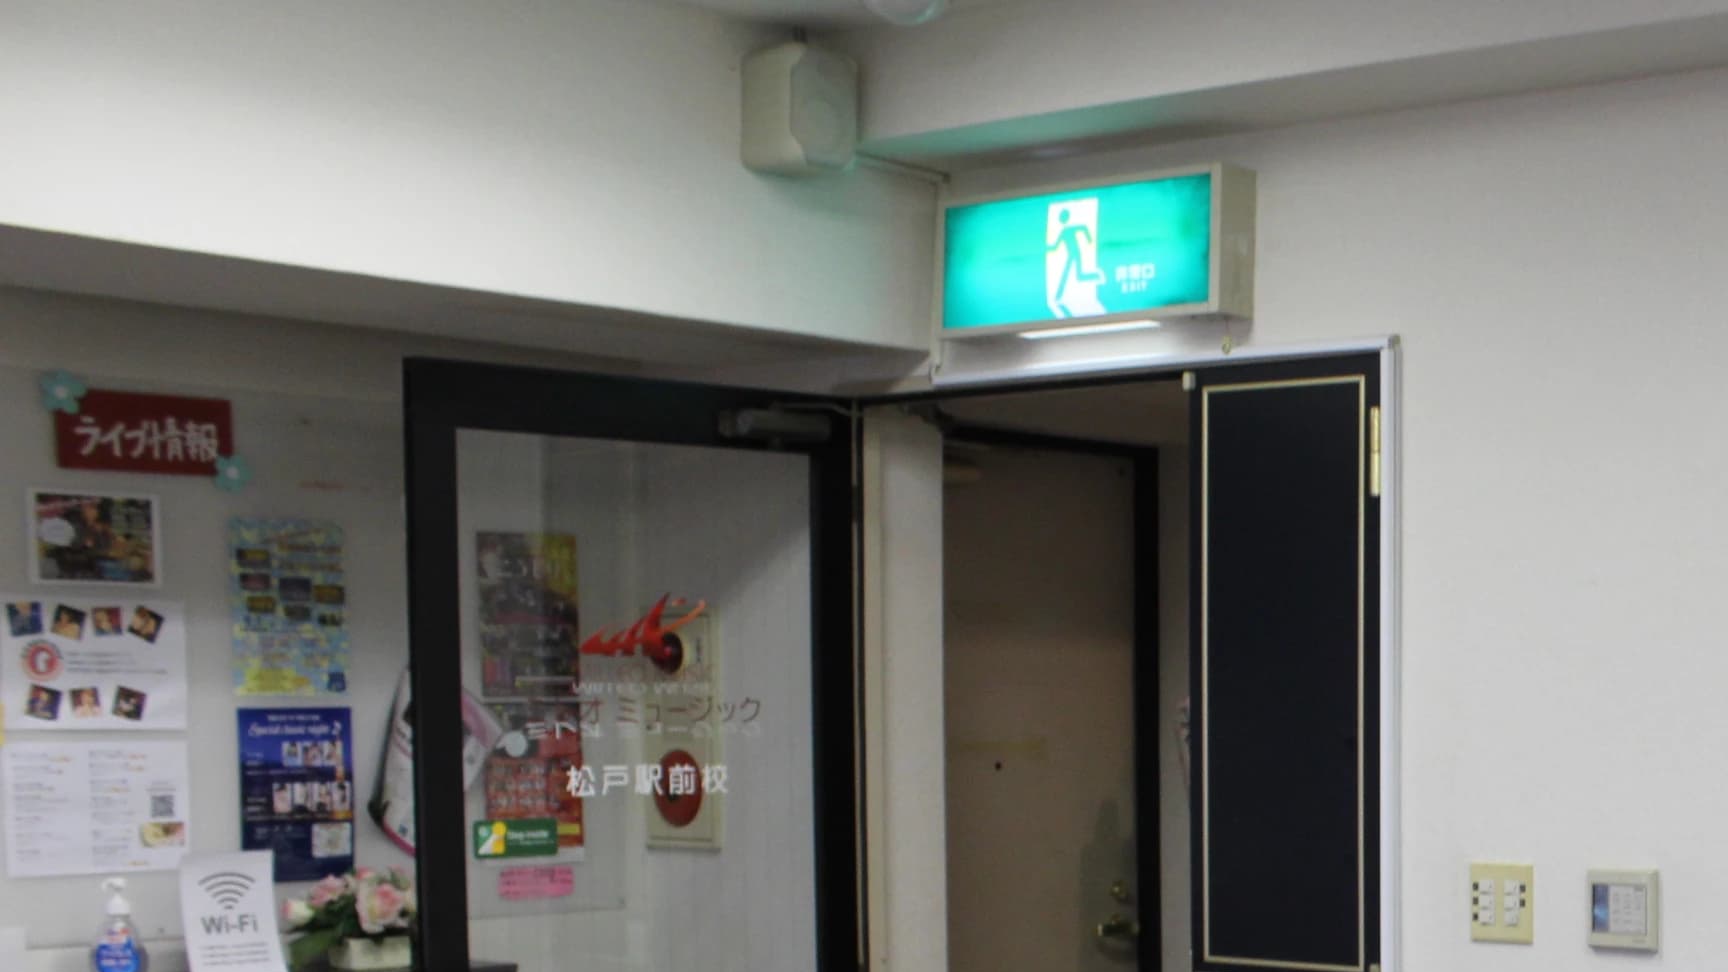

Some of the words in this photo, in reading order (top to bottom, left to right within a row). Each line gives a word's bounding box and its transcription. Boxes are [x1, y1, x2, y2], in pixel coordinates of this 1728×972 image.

[74, 416, 219, 463] ライブ情報
[566, 763, 729, 798] 松戸駅前校
[201, 914, 259, 935] Wi-Fi
